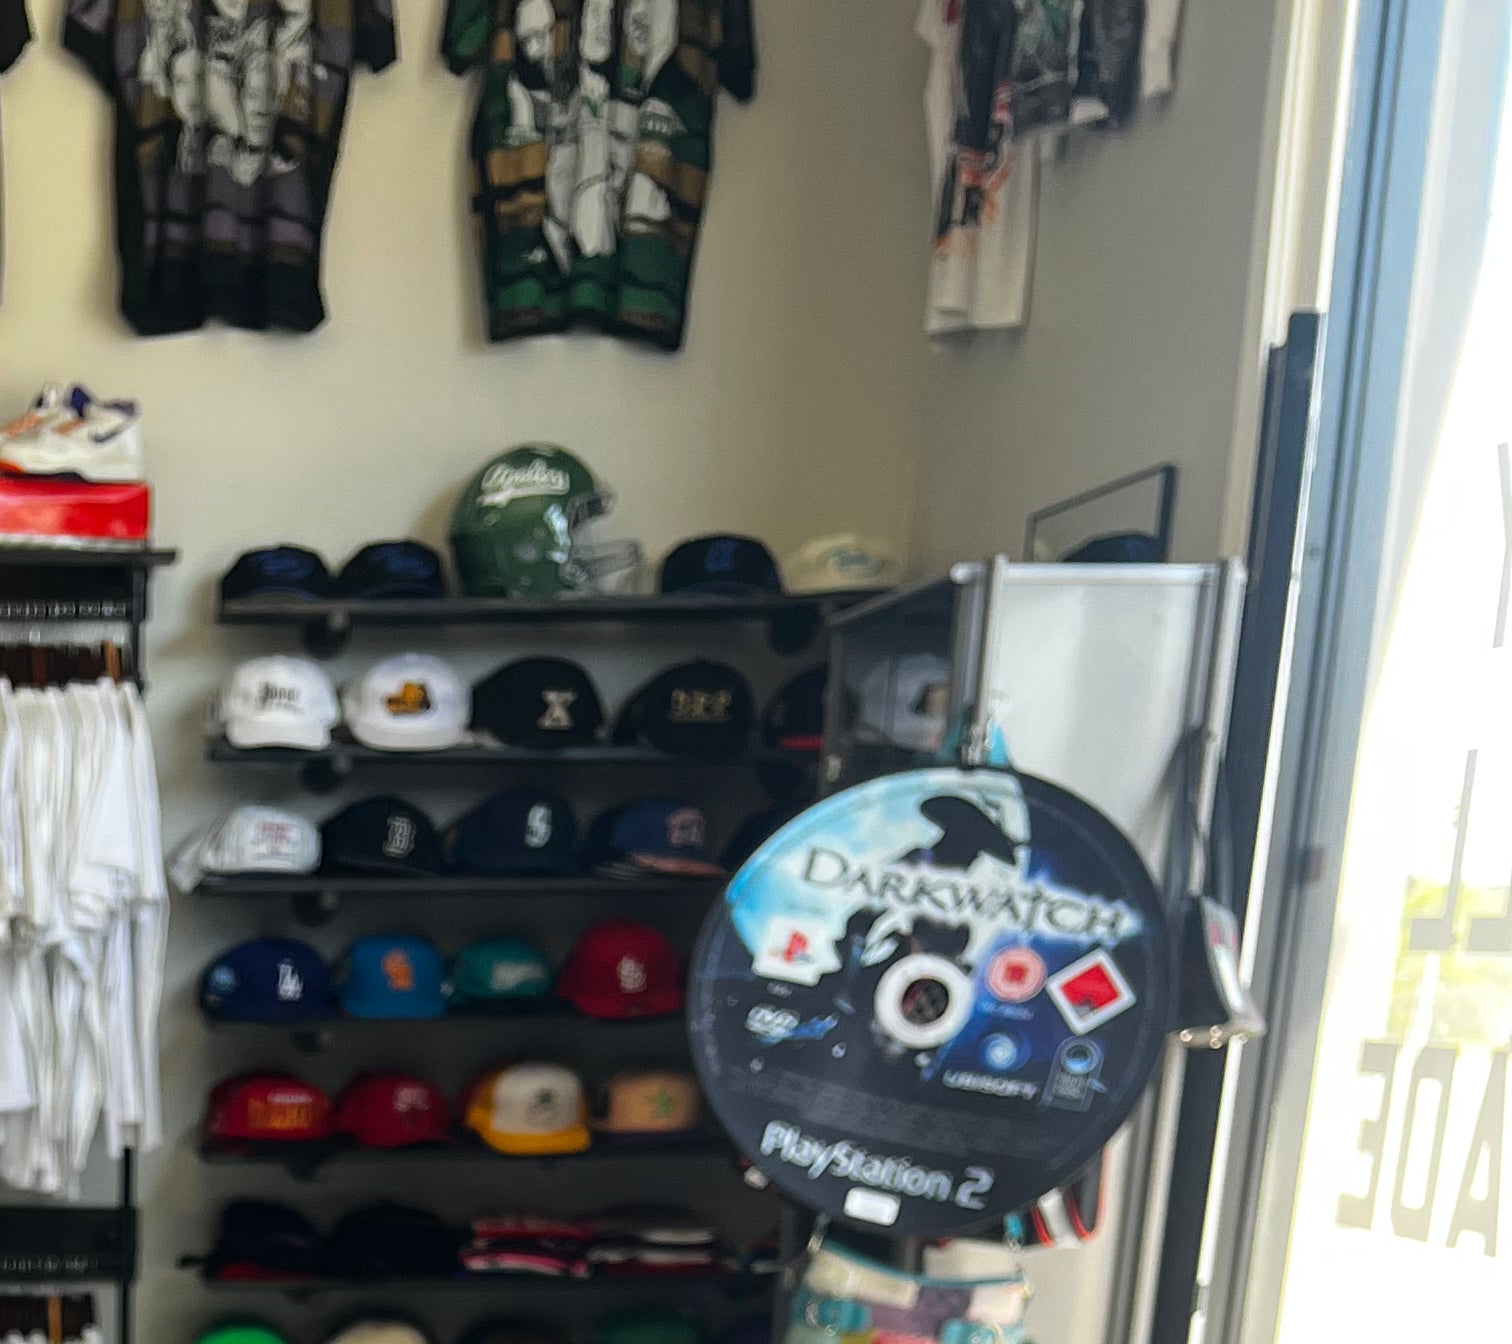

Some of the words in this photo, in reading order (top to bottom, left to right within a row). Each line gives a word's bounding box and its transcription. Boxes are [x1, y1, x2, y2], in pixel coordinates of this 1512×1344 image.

[804, 846, 1126, 938] DARKWATCH
[760, 1119, 954, 1202] PlayStation
[954, 1165, 996, 1211] 2
